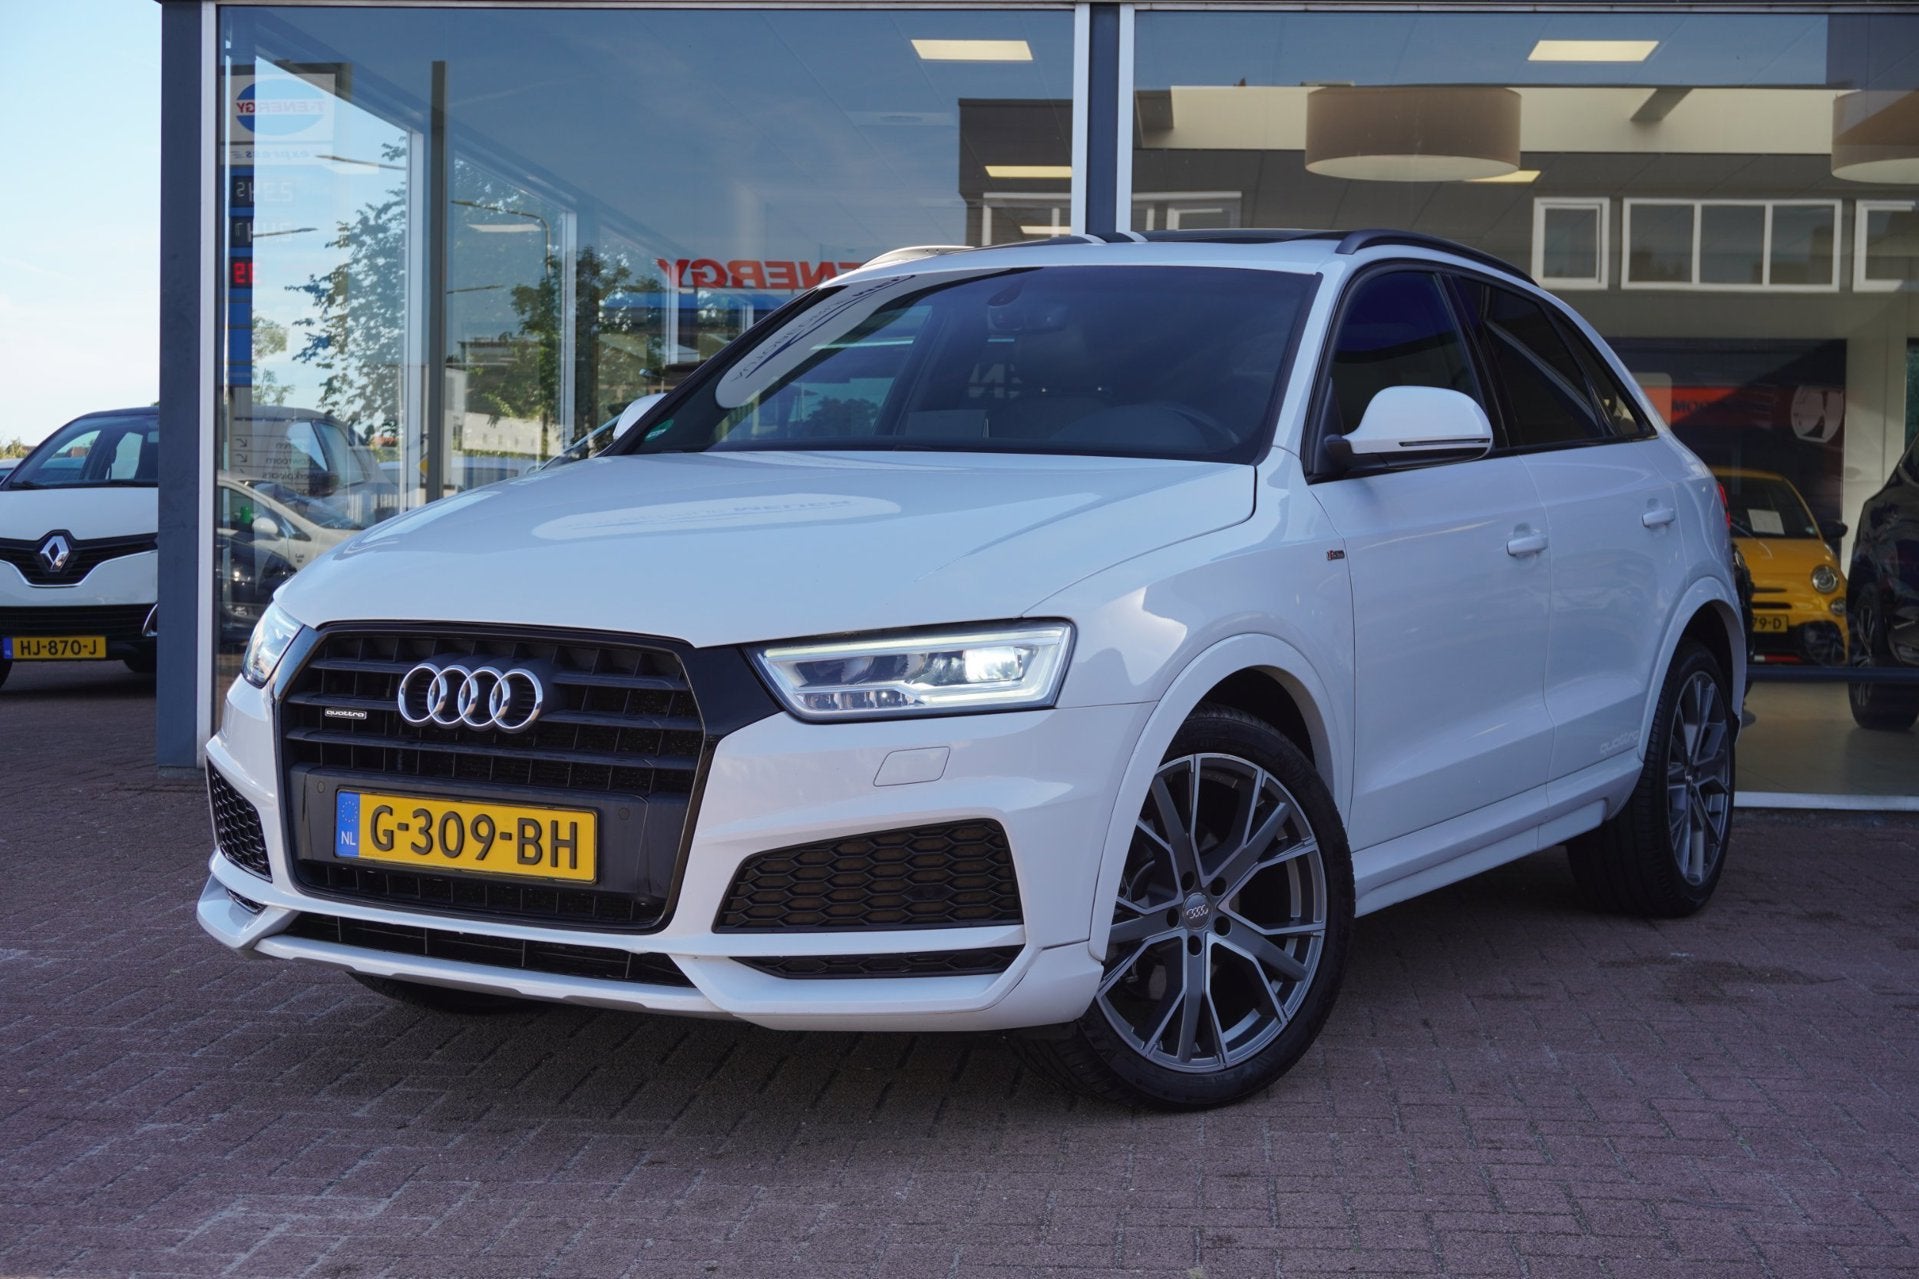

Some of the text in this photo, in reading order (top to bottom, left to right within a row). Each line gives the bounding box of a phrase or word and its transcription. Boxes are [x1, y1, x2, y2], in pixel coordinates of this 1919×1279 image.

[20, 640, 97, 655] HJ-870-J
[326, 709, 365, 718] quattro
[341, 831, 356, 846] NL
[370, 805, 578, 869] G-309-BH
